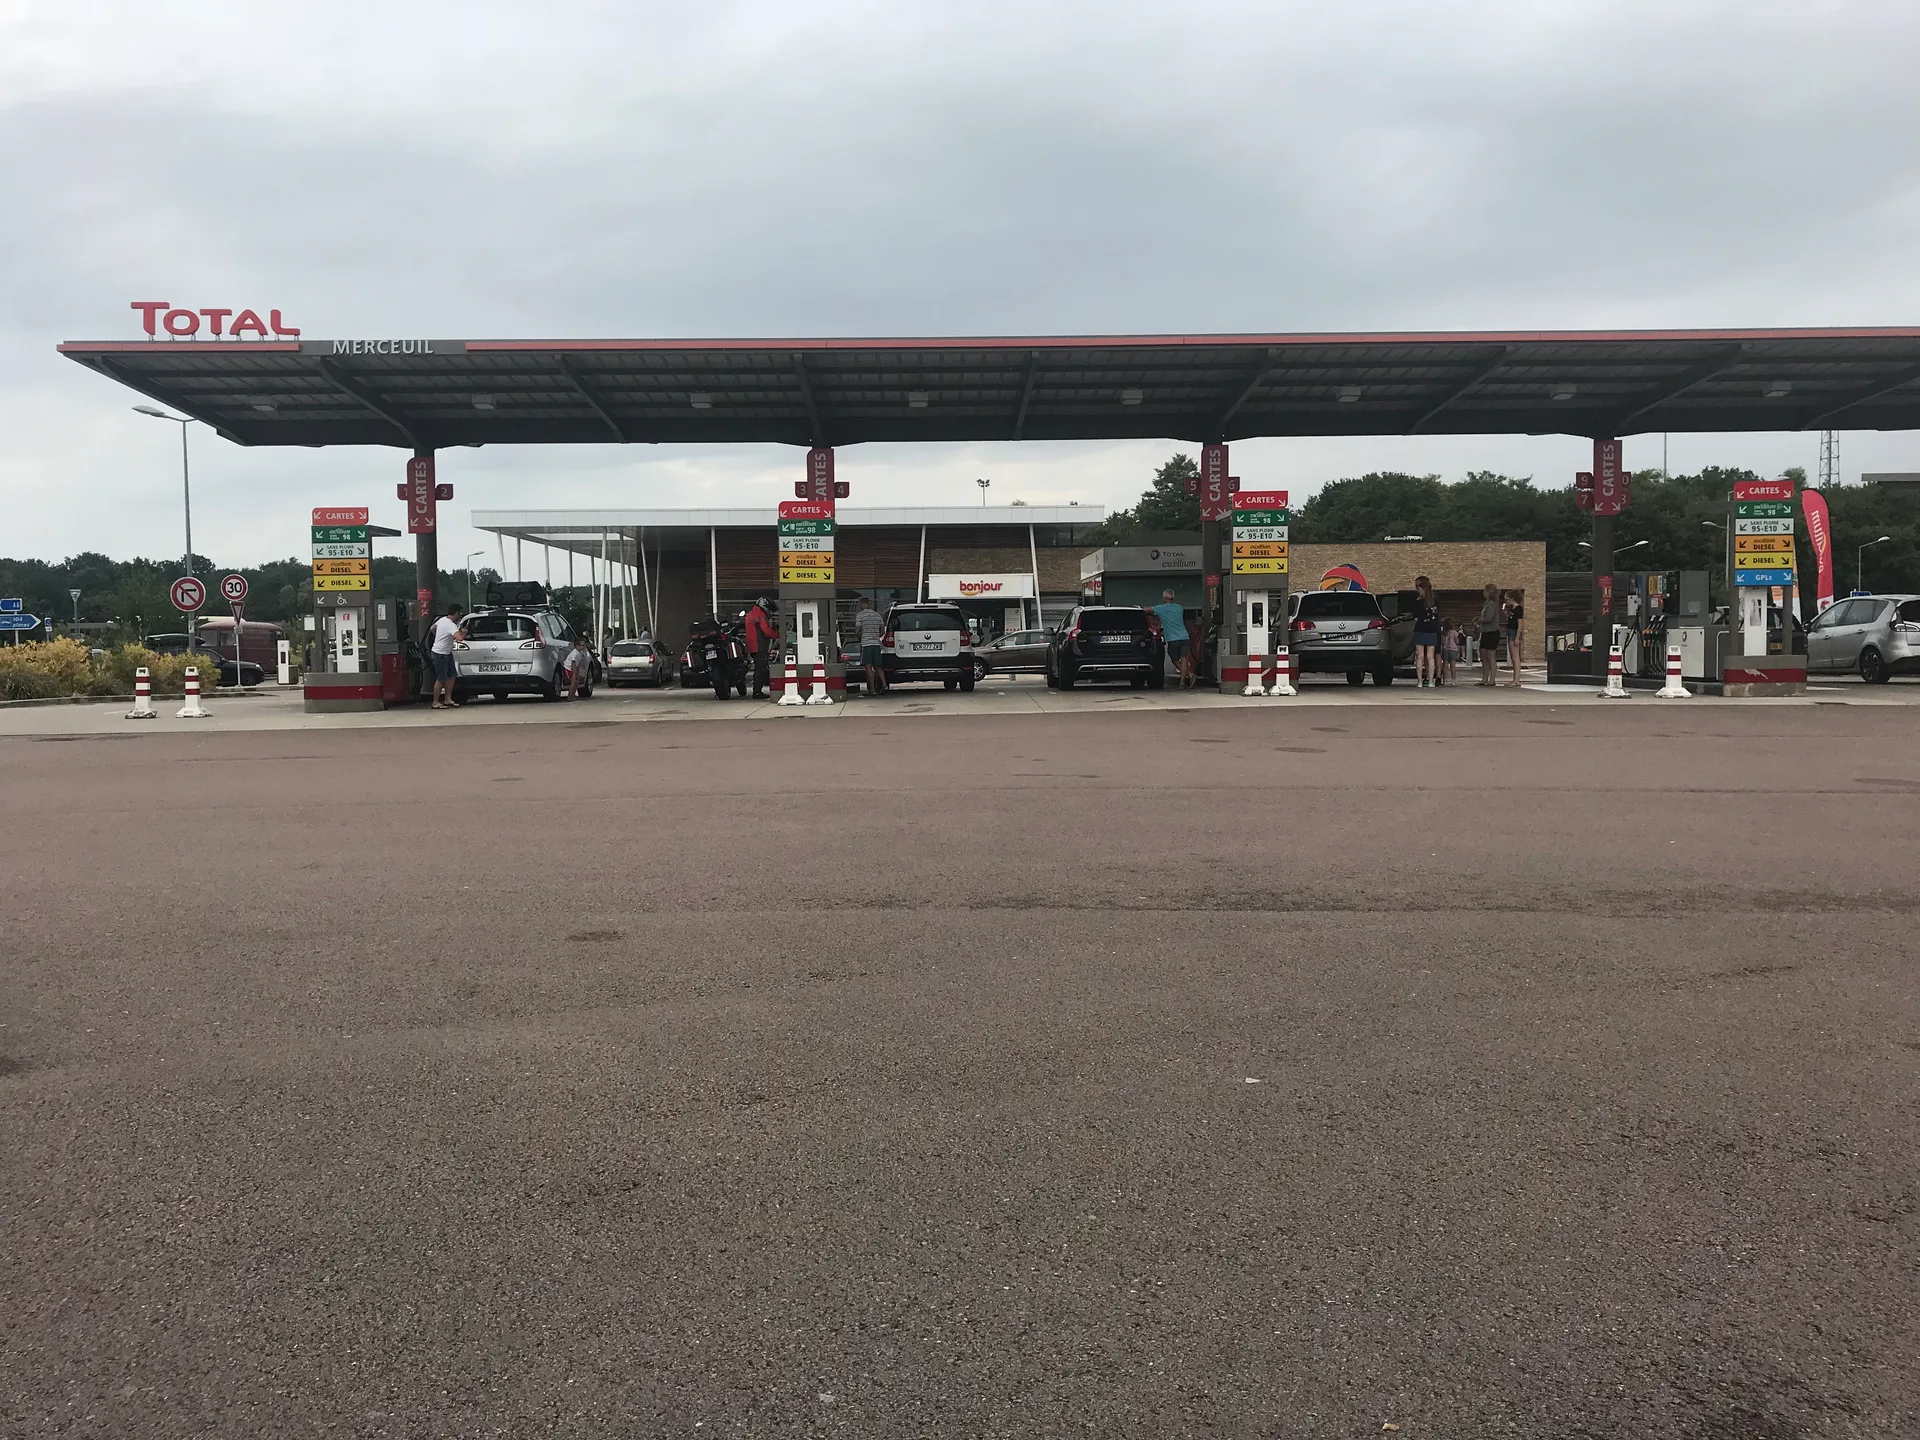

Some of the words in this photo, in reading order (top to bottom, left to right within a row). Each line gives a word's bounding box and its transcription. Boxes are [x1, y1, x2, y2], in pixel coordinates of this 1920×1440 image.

[131, 301, 300, 336] TOTAL
[332, 339, 434, 356] MERCEUIL
[1209, 449, 1221, 502] CARTES
[1602, 444, 1614, 497] CARTES
[815, 453, 827, 501] ARTES
[1581, 475, 1589, 486] 9
[415, 461, 427, 514] CARTES
[800, 484, 807, 495] 3
[837, 484, 845, 495] 4
[1190, 480, 1197, 491] 5
[1228, 479, 1235, 490] 6
[440, 487, 449, 498] 2
[1749, 486, 1780, 495] CARTES
[1246, 496, 1275, 504] CARTES
[1580, 494, 1588, 505] 7
[792, 506, 821, 514] CARTES
[325, 512, 355, 520] CARTES
[807, 526, 816, 534] 98
[794, 542, 819, 550] 95-E10
[1161, 558, 1196, 568] excellium
[227, 582, 243, 593] 30
[959, 580, 1003, 593] bonjour
